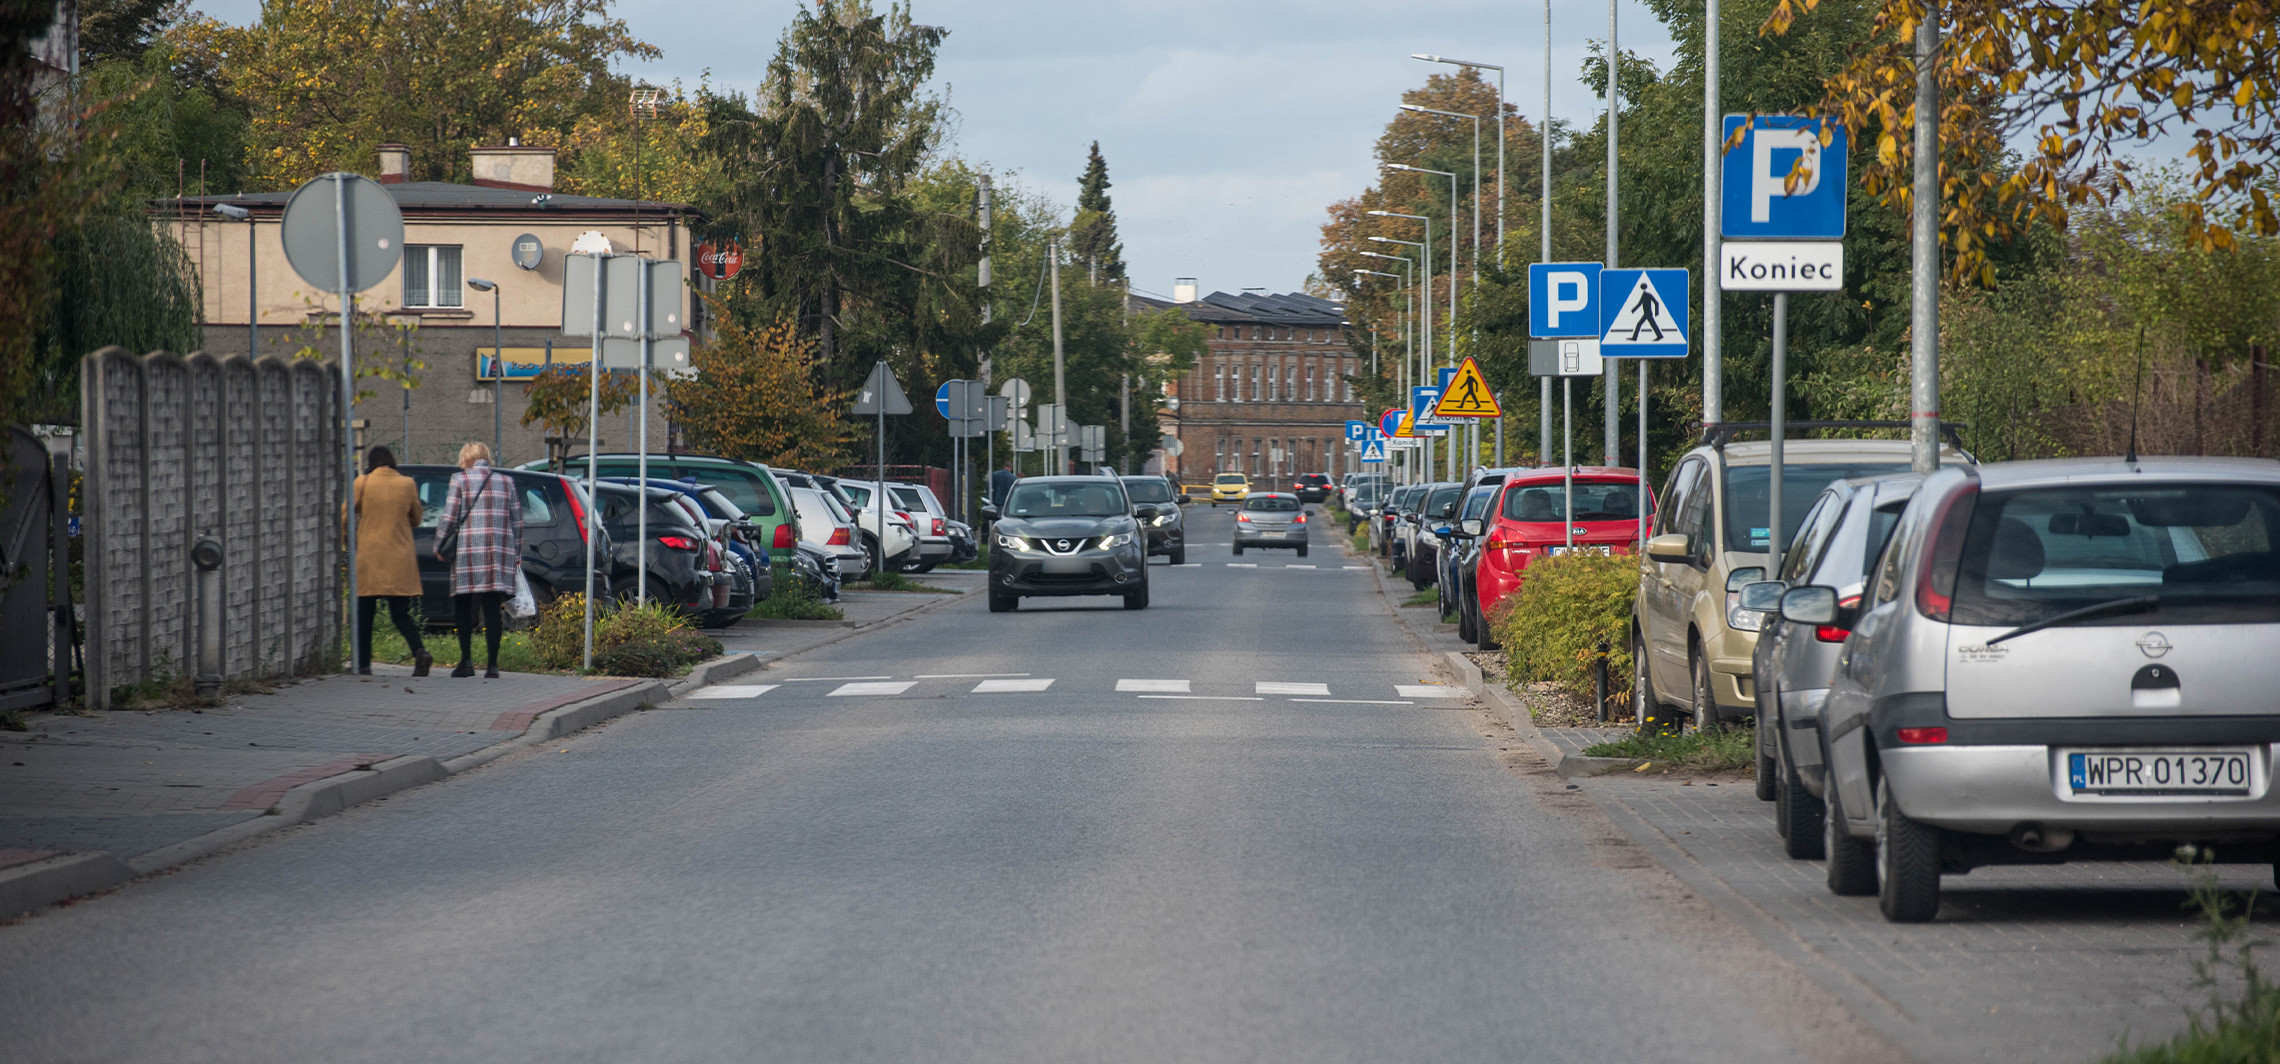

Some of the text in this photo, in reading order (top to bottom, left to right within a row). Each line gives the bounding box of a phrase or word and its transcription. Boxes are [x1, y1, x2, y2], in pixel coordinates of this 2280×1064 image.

[1751, 129, 1820, 223] P
[1730, 255, 1833, 280] Koniec
[1547, 271, 1588, 328] P
[1352, 425, 1364, 439] P
[2073, 775, 2085, 784] PL
[2087, 757, 2244, 785] WPR 01370
